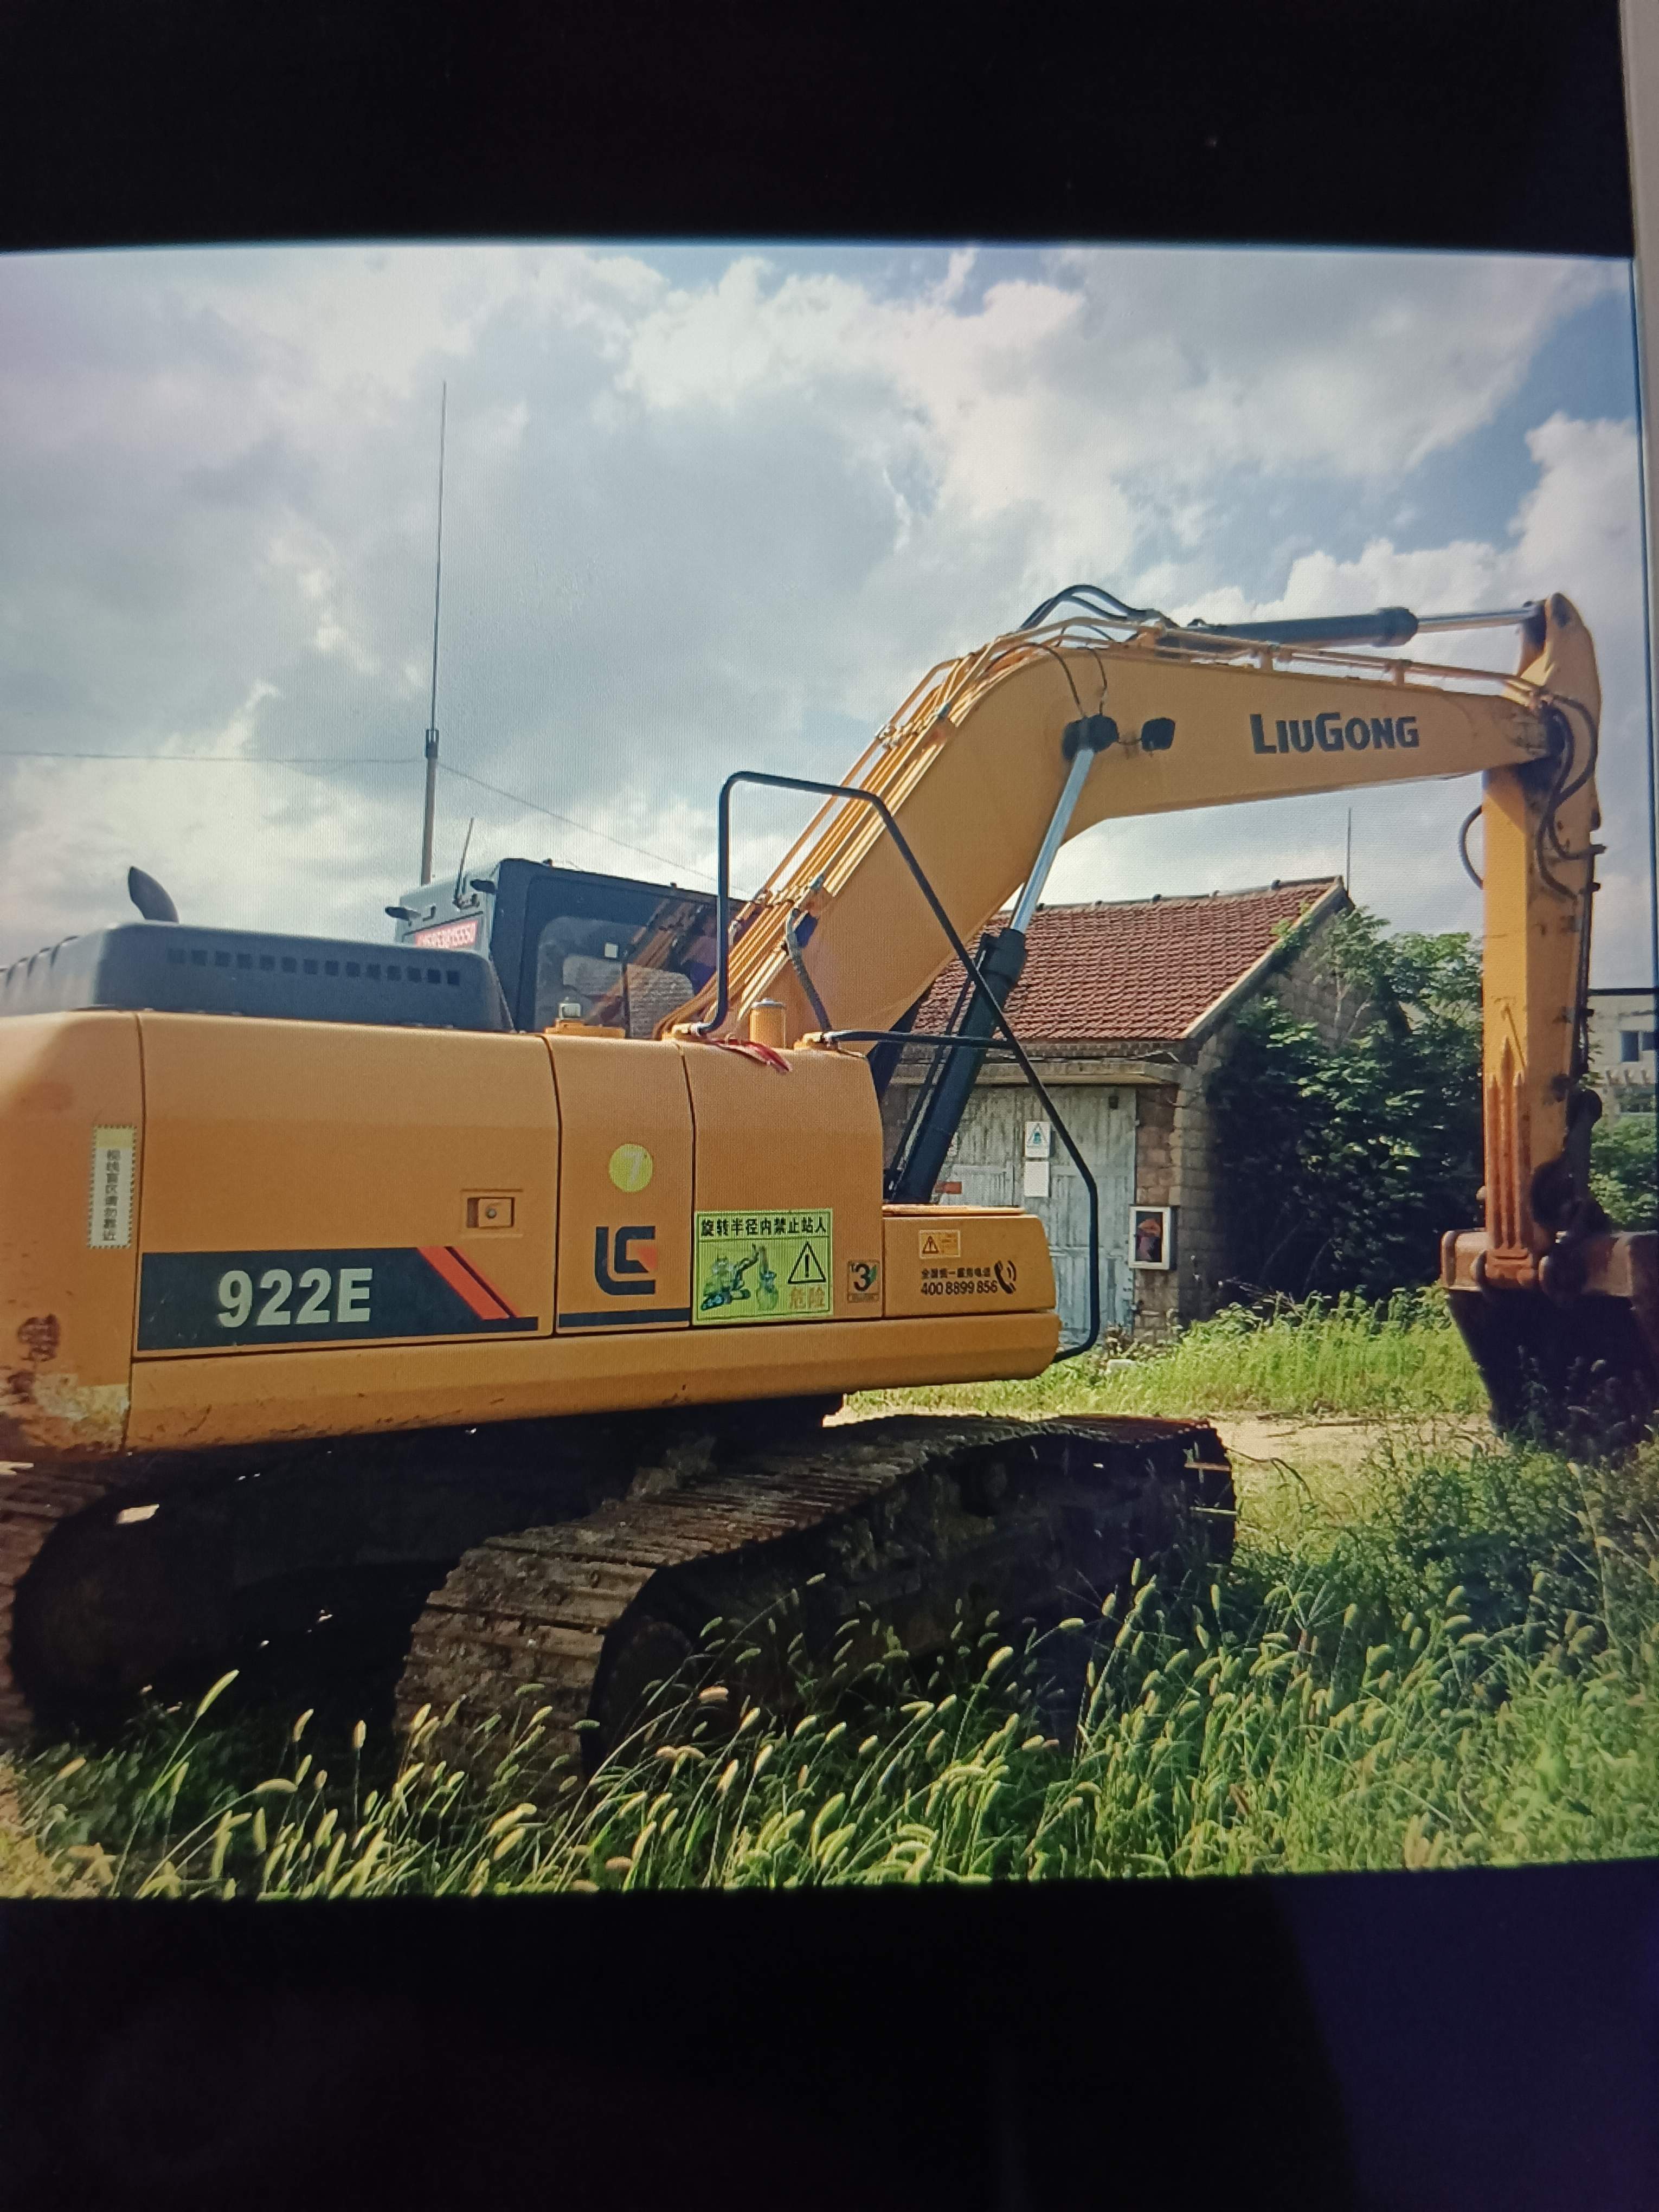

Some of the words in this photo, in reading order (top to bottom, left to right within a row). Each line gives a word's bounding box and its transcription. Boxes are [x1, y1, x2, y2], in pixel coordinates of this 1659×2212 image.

[700, 1216, 826, 1237] 旋转半径内禁止站人
[218, 1268, 373, 1328] 922E
[921, 1281, 943, 1296] 400
[945, 1281, 975, 1295] 8899
[976, 1279, 998, 1294] 856
